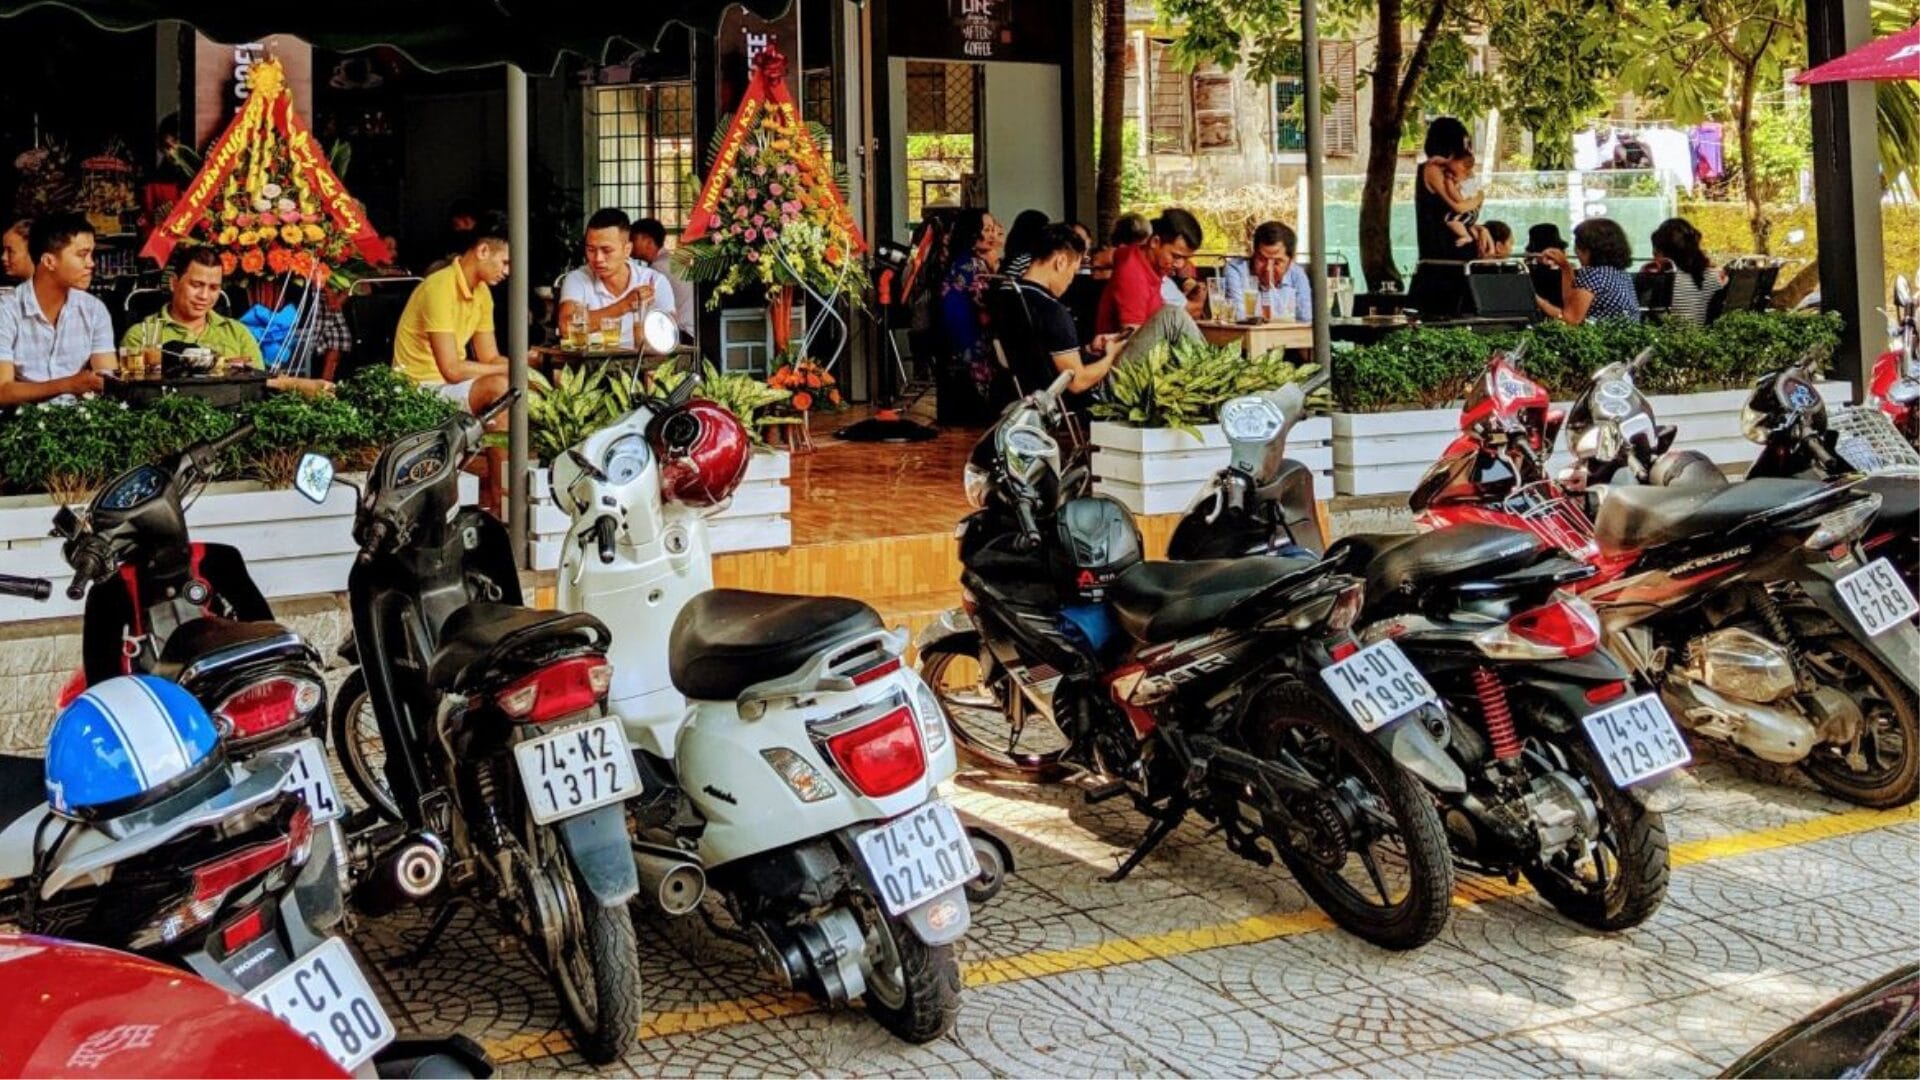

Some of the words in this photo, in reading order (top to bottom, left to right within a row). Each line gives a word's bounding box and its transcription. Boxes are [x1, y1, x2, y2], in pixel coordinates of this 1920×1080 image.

[964, 41, 993, 56] COFFEE
[1860, 589, 1909, 628] 6789
[1334, 648, 1398, 692] 74-D1
[1352, 671, 1427, 724] 019.96
[1596, 701, 1658, 744] 74-C1
[534, 727, 612, 776] 74-K2
[543, 762, 622, 811] 1372
[873, 808, 947, 866] 74-C1
[883, 840, 971, 906] 024.07
[232, 947, 275, 977] HONDA
